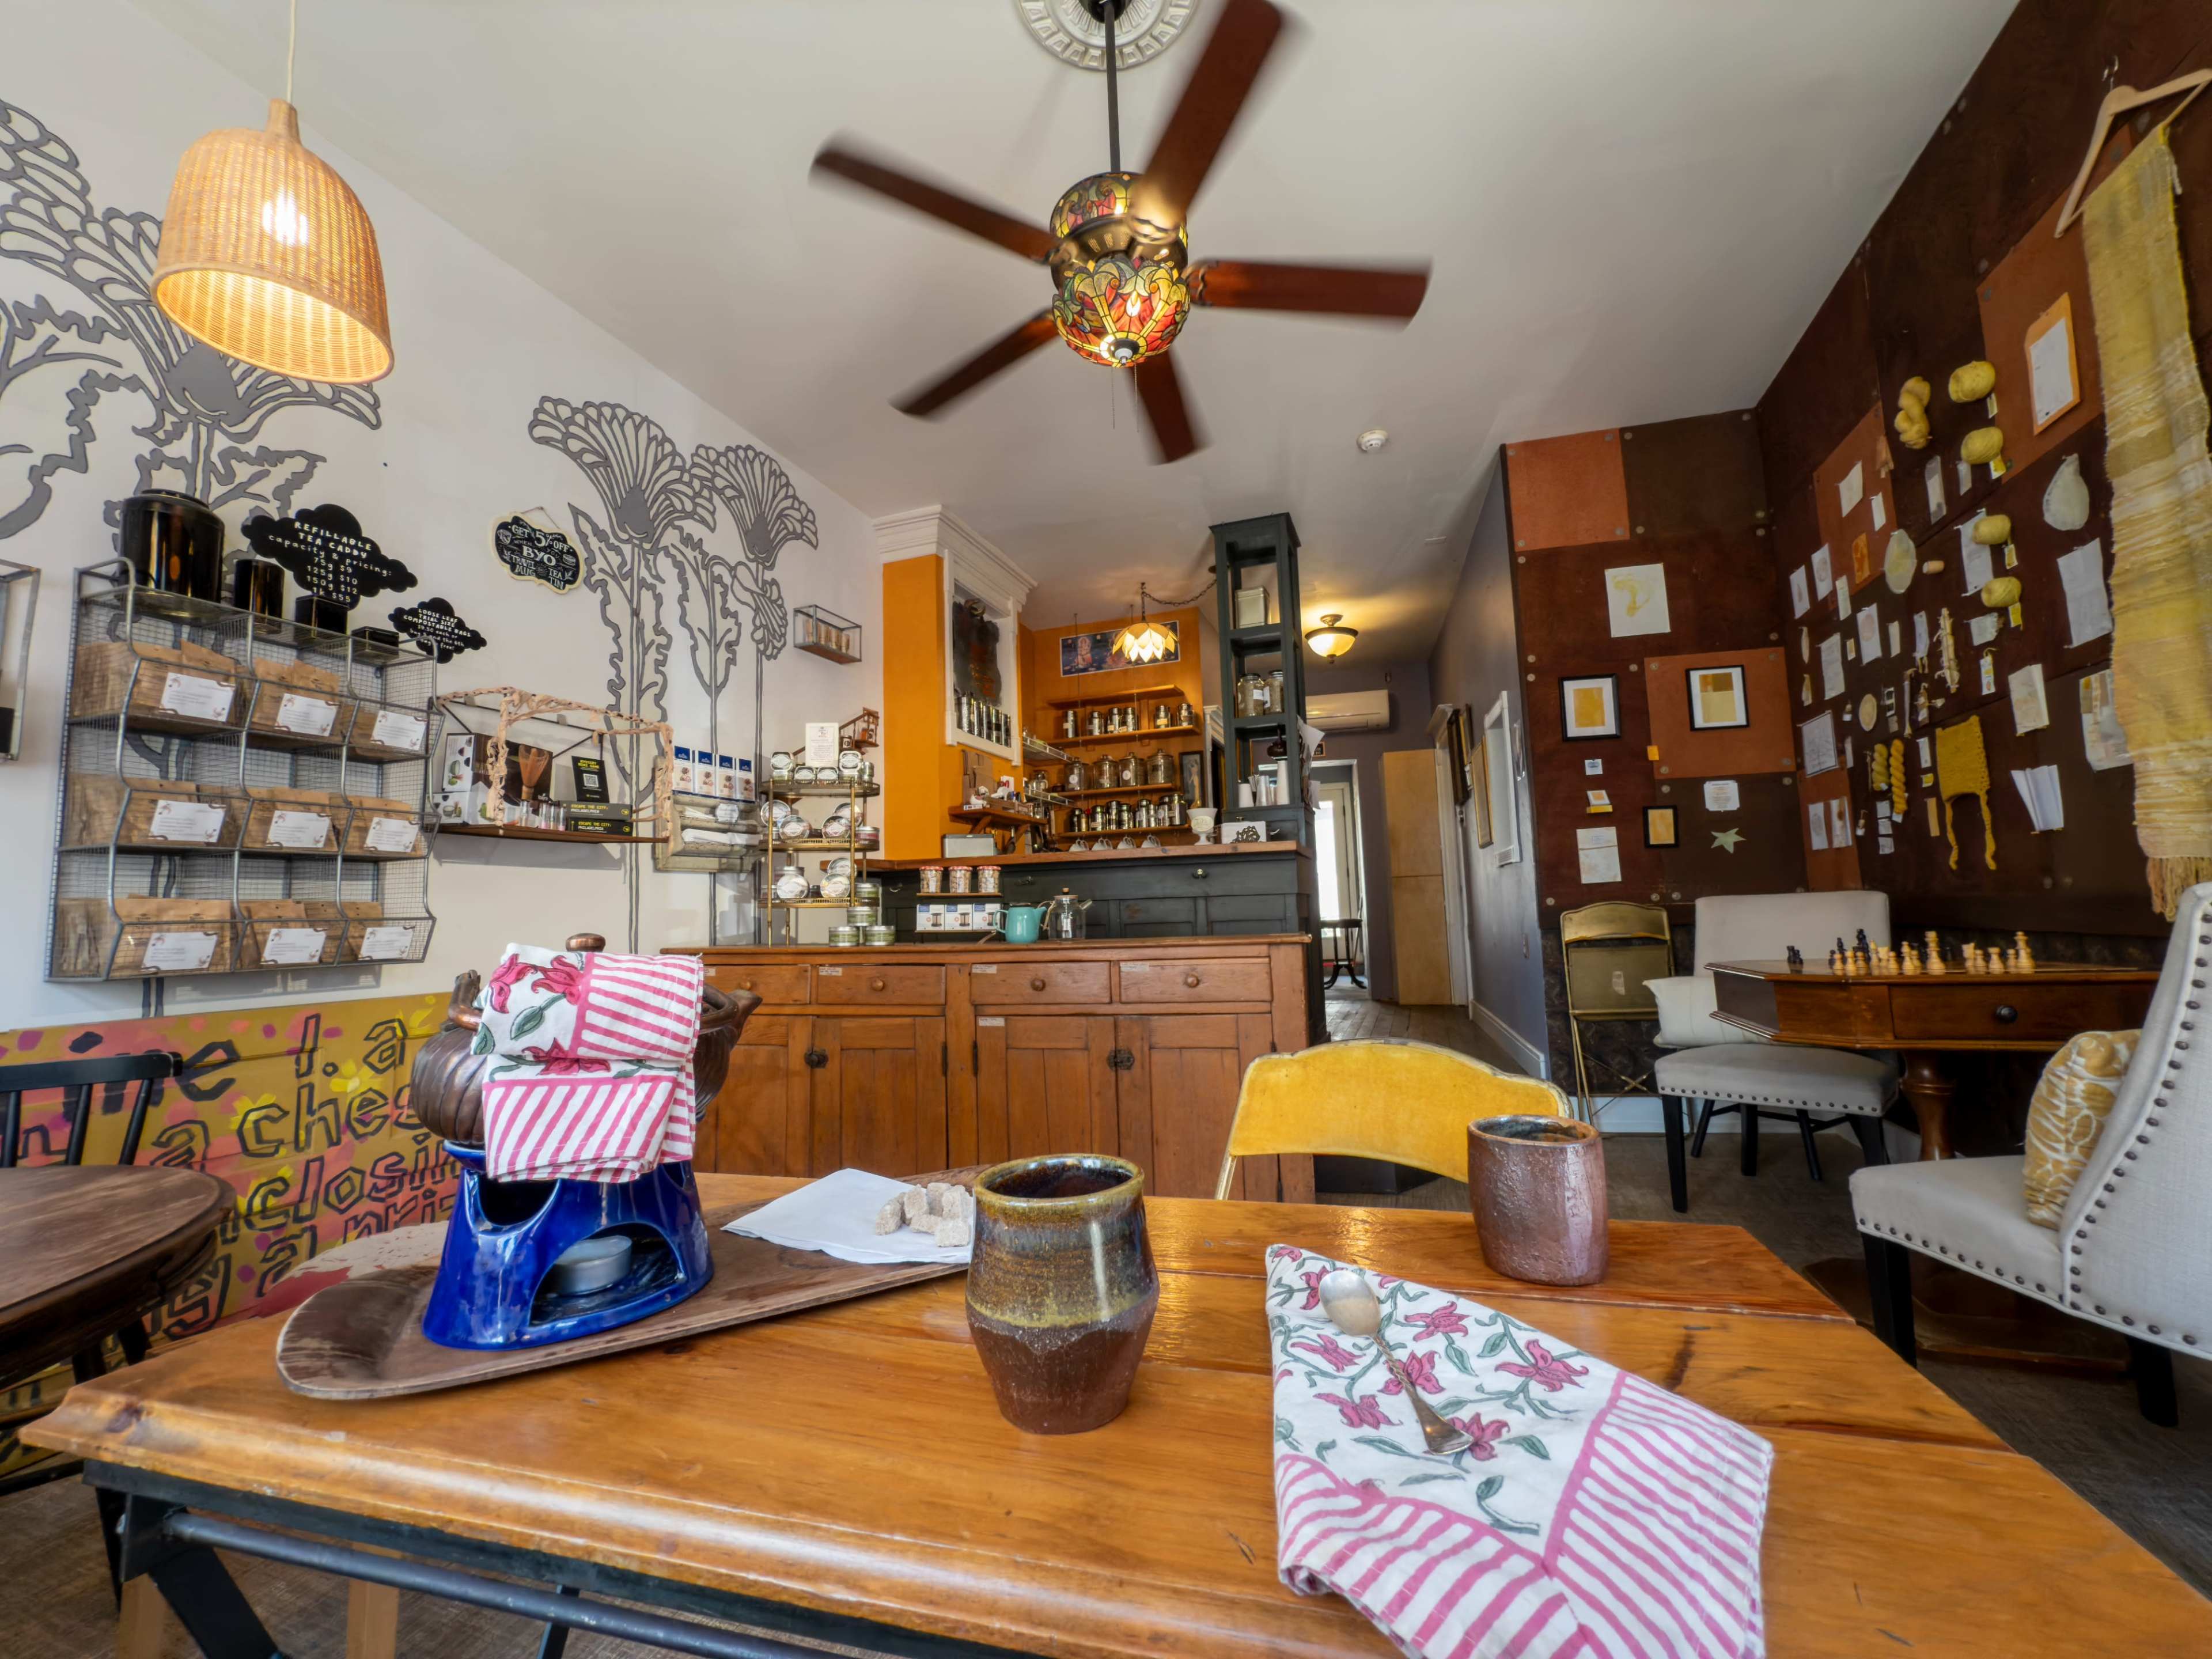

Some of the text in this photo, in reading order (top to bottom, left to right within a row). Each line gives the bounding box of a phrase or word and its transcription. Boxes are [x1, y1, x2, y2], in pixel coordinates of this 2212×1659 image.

[294, 521, 372, 551] REFILLABLE
[511, 525, 570, 553] GET 5% OFF
[298, 532, 367, 559] TEA CADDY
[268, 535, 392, 577] capacity & pricing:
[510, 554, 536, 569] TRAVEL
[522, 545, 556, 566] BYO
[313, 557, 333, 571] 75g
[515, 566, 536, 577] MUG
[307, 566, 333, 581] 125g
[548, 567, 563, 580] TEA
[307, 575, 333, 591] 150g
[548, 576, 564, 590] TIN
[313, 586, 325, 597] 1k
[418, 608, 458, 623] LOOSE LEAF
[418, 613, 456, 628] TRIAL SIZE
[403, 615, 471, 637] COMPOSTABLE BAGS
[410, 628, 421, 638] buy
[442, 636, 453, 644] the
[362, 1018, 408, 1074] a
